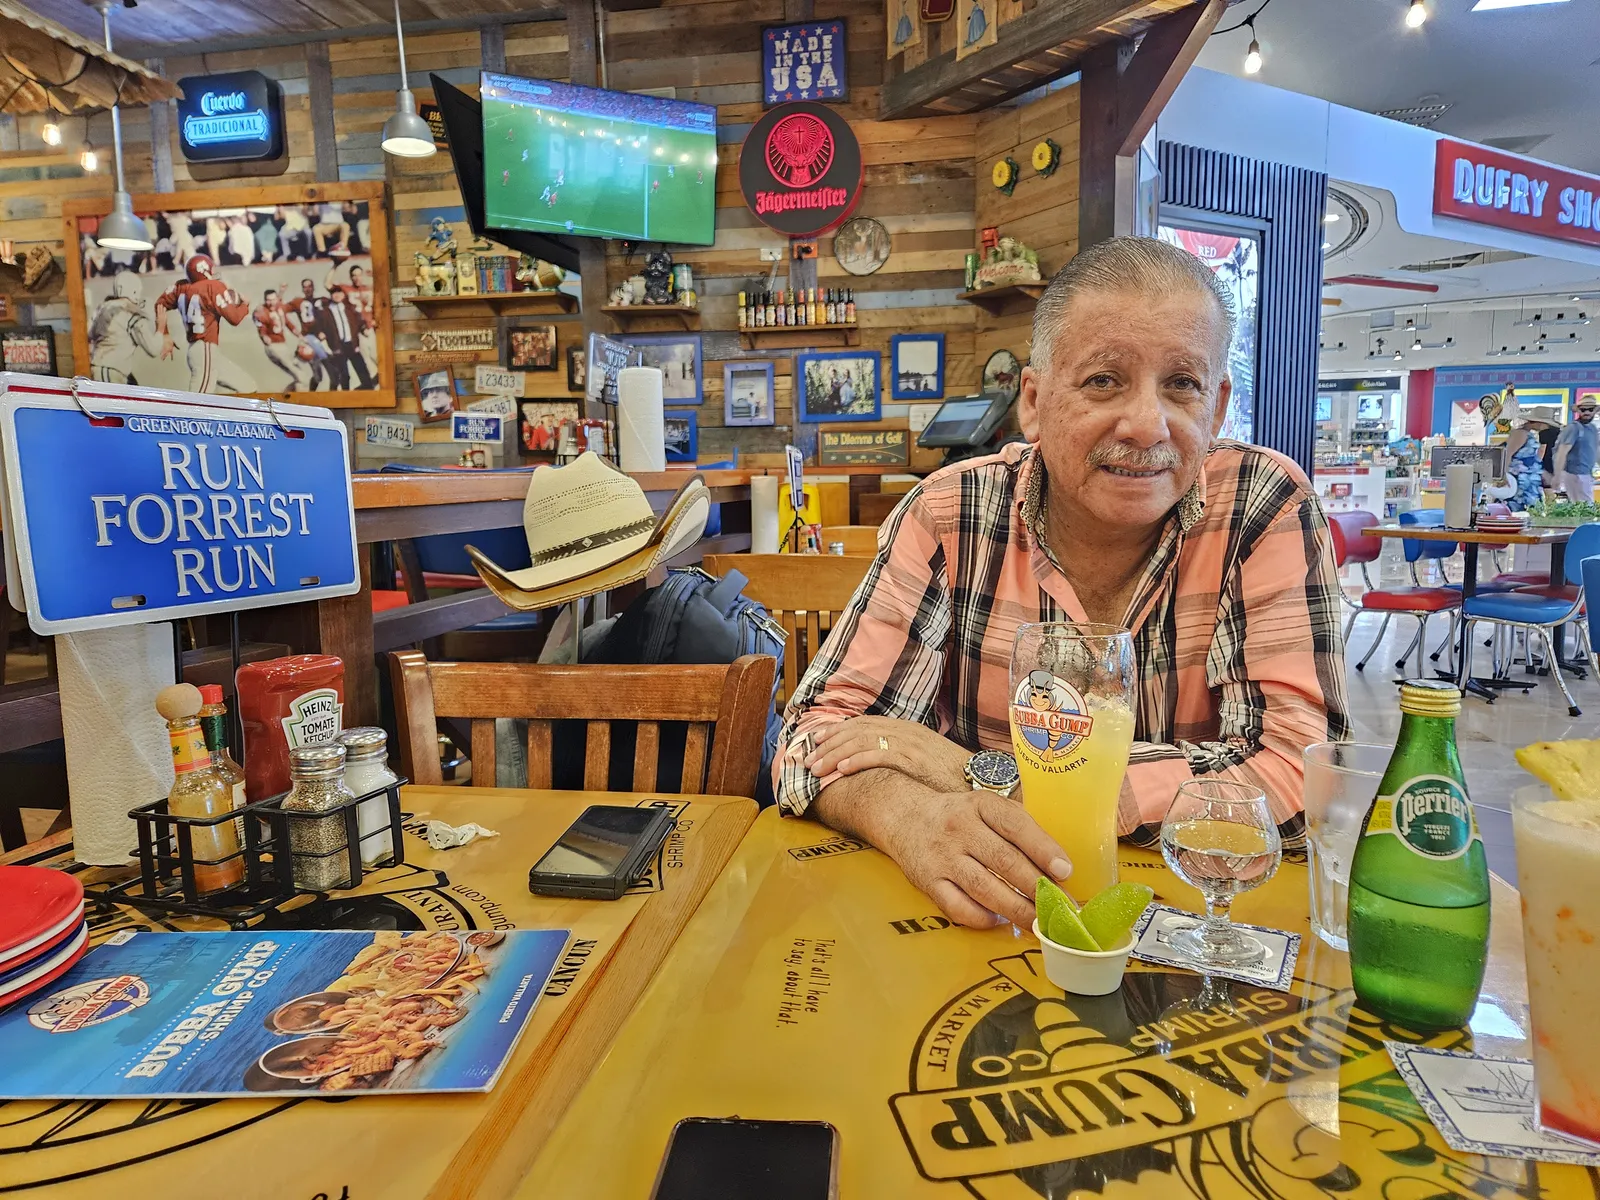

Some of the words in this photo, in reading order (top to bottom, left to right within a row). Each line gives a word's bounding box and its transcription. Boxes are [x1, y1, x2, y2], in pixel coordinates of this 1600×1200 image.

[774, 34, 833, 55] MADE
[775, 55, 793, 67] IN
[800, 50, 833, 65] THE
[770, 64, 838, 91] USA
[200, 91, 246, 116] Cuervo
[192, 118, 259, 135] TRADICIONAL
[1453, 158, 1549, 217] DUFRY
[755, 187, 848, 215] Jägermeister
[1197, 245, 1217, 258] RED
[975, 264, 1025, 280] Welcome
[438, 333, 492, 349] FOOTBALL
[485, 373, 516, 389] 23433
[127, 416, 214, 437] GREENBOW,
[216, 424, 278, 440] ALABAMA
[824, 433, 839, 445] The
[875, 432, 885, 444] of
[157, 441, 265, 491] RUN
[91, 492, 315, 548] FORREST
[172, 543, 277, 598] RUN
[303, 701, 332, 717] HEINZ
[1013, 707, 1047, 728] BUBBA
[1048, 713, 1090, 734] GUMP
[301, 717, 335, 736] TOMATE
[1021, 726, 1048, 736] SHRIMP
[1016, 743, 1040, 769] PUERTO
[1042, 757, 1089, 774] VALLARTA
[676, 820, 694, 832] CO
[667, 833, 686, 869] SHRIMP
[796, 840, 864, 858] GUMP
[1119, 861, 1166, 870] CHIC
[888, 916, 965, 936] CH
[793, 938, 813, 947] to
[811, 938, 836, 964] That's
[544, 938, 599, 997] CANCUN
[783, 949, 805, 967] say,
[783, 971, 803, 997] about
[810, 966, 830, 980] all
[511, 973, 534, 1002] VALLARTA
[990, 981, 1014, 993] &
[56, 997, 104, 1031] BUBBA
[97, 977, 134, 999] GUMP
[124, 1000, 232, 1079] BUBBA
[211, 940, 281, 996] GUMP
[804, 989, 829, 1013] have
[198, 990, 255, 1040] SHRIMP
[776, 1001, 802, 1028] that.
[1130, 990, 1289, 1049] SHRIMP
[927, 993, 991, 1073] MARKET
[972, 1049, 1050, 1078] CO
[931, 1068, 1197, 1151] GUMP
